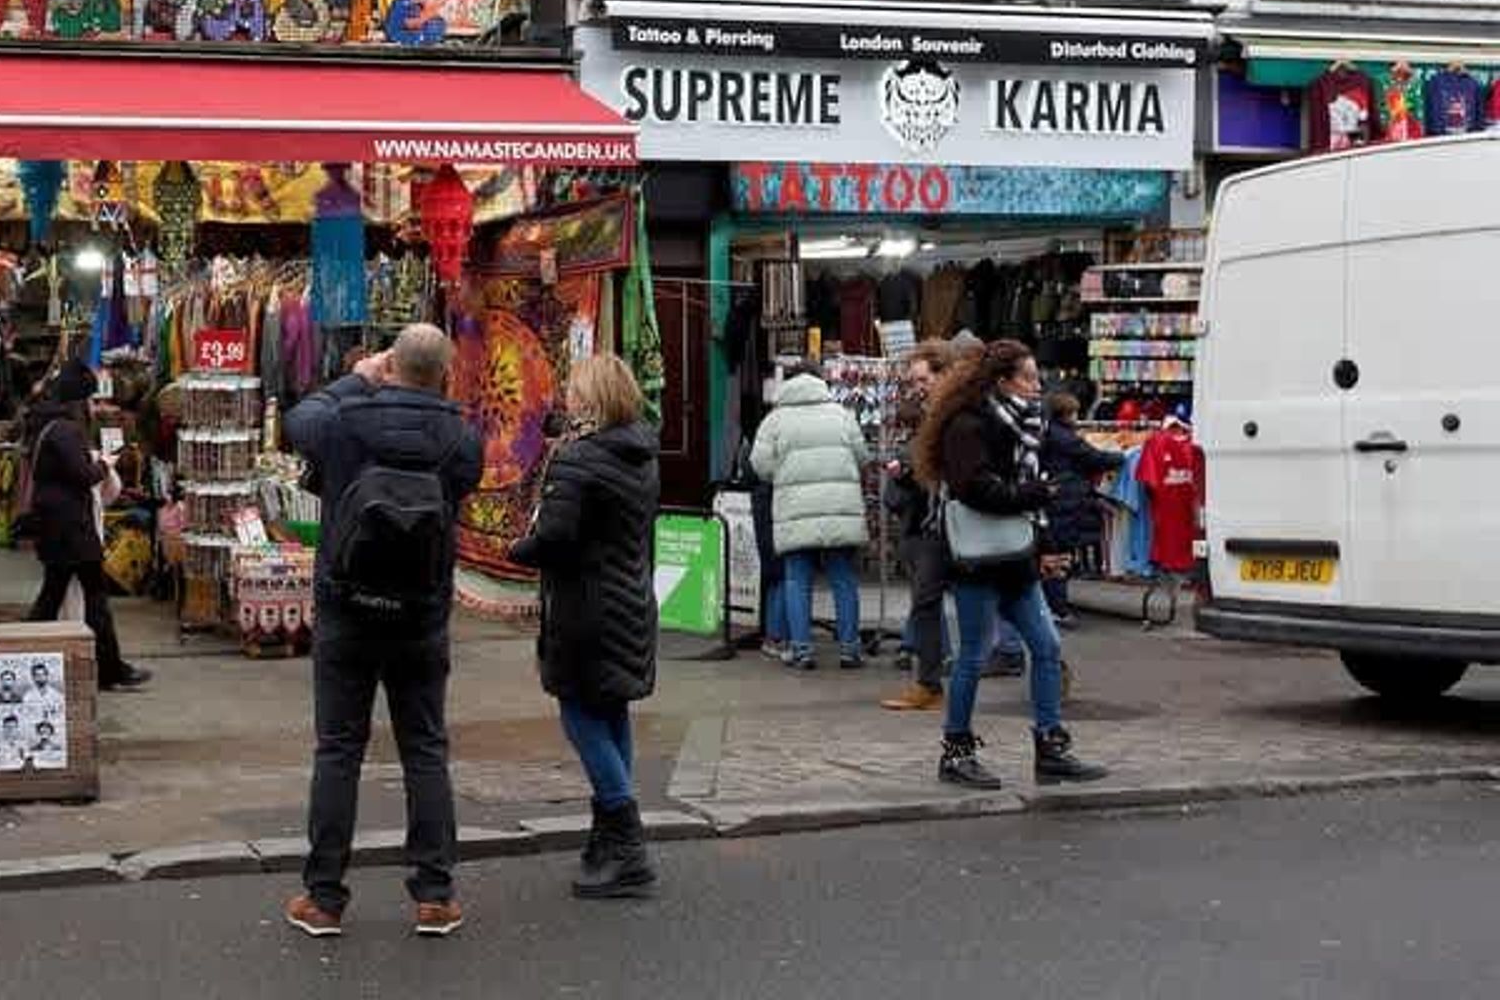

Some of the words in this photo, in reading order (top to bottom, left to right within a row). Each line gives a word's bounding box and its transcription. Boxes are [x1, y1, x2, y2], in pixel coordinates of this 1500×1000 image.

[627, 25, 682, 43] Tattoo
[704, 28, 774, 50] Piercing
[839, 33, 903, 50] London
[911, 34, 984, 54] Souvenir
[1131, 42, 1196, 64] Clothing
[622, 67, 841, 124] SUPREME
[996, 80, 1166, 134] KARMA
[739, 161, 950, 214] TATTOO
